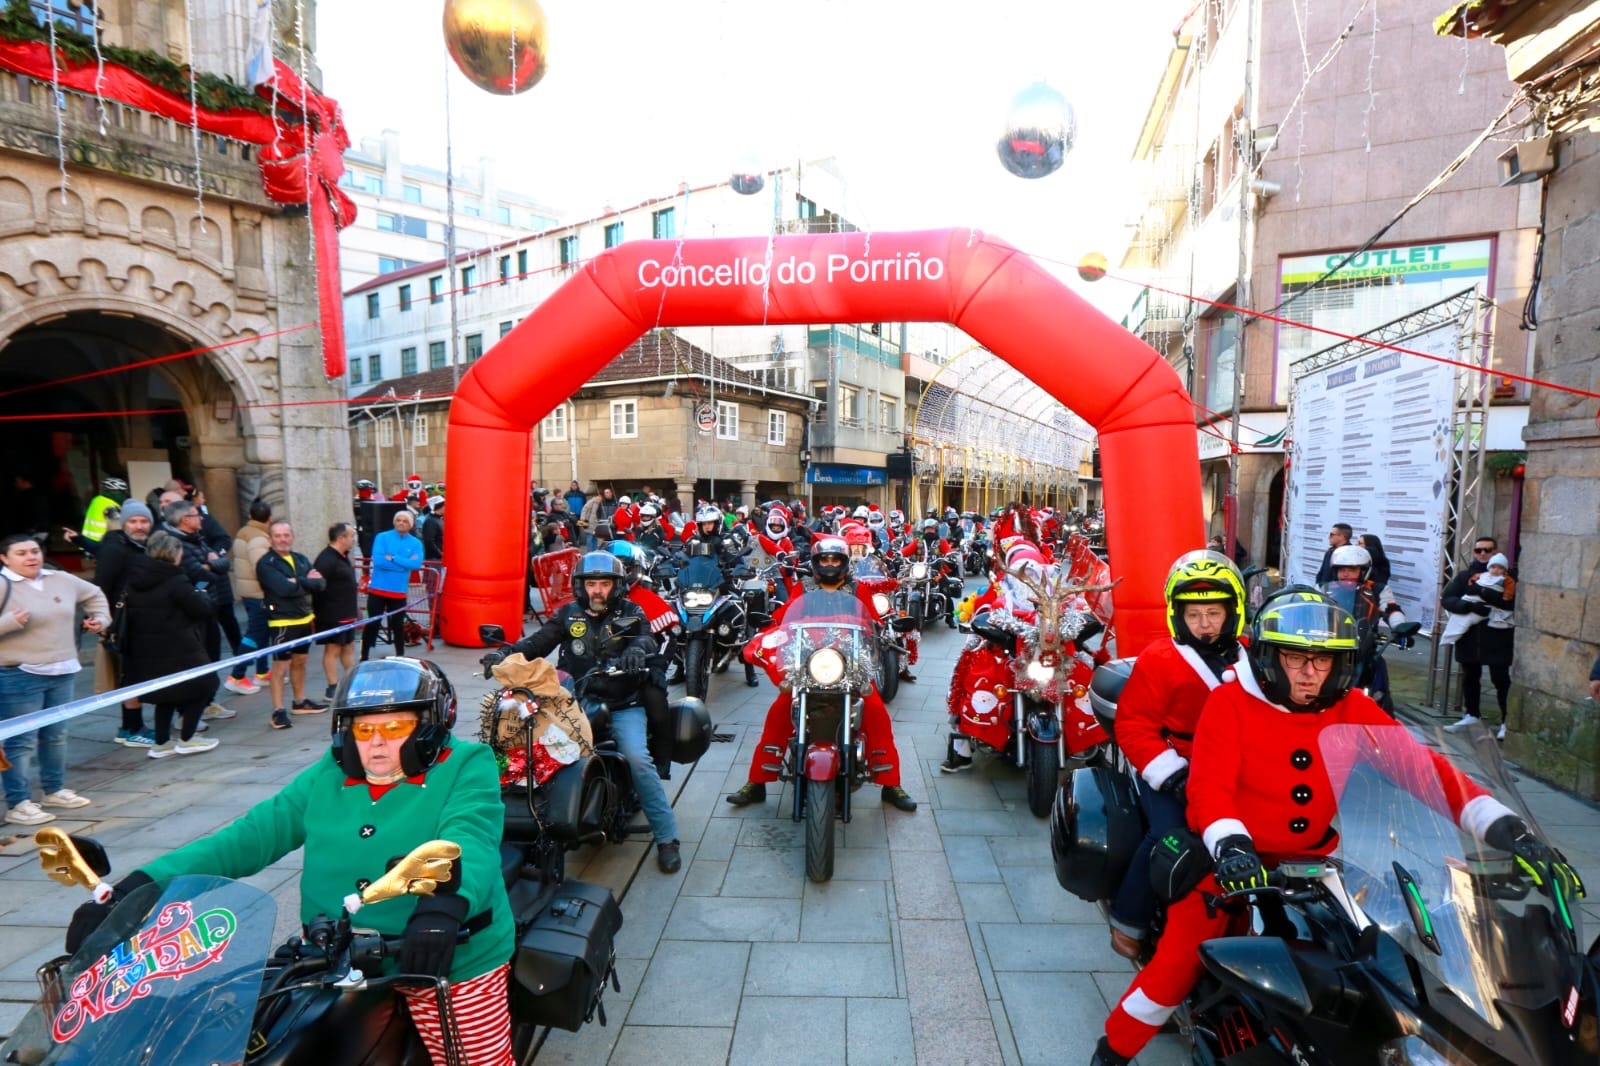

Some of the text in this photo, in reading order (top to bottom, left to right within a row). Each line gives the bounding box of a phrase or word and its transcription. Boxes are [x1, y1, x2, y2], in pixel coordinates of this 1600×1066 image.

[69, 145, 234, 195] CONSISTORAL
[638, 251, 944, 288] Concello do Porriño
[1326, 245, 1446, 269] OUTLET
[52, 908, 237, 1043] NAVIDAD
[70, 901, 193, 1000] FELIZ
